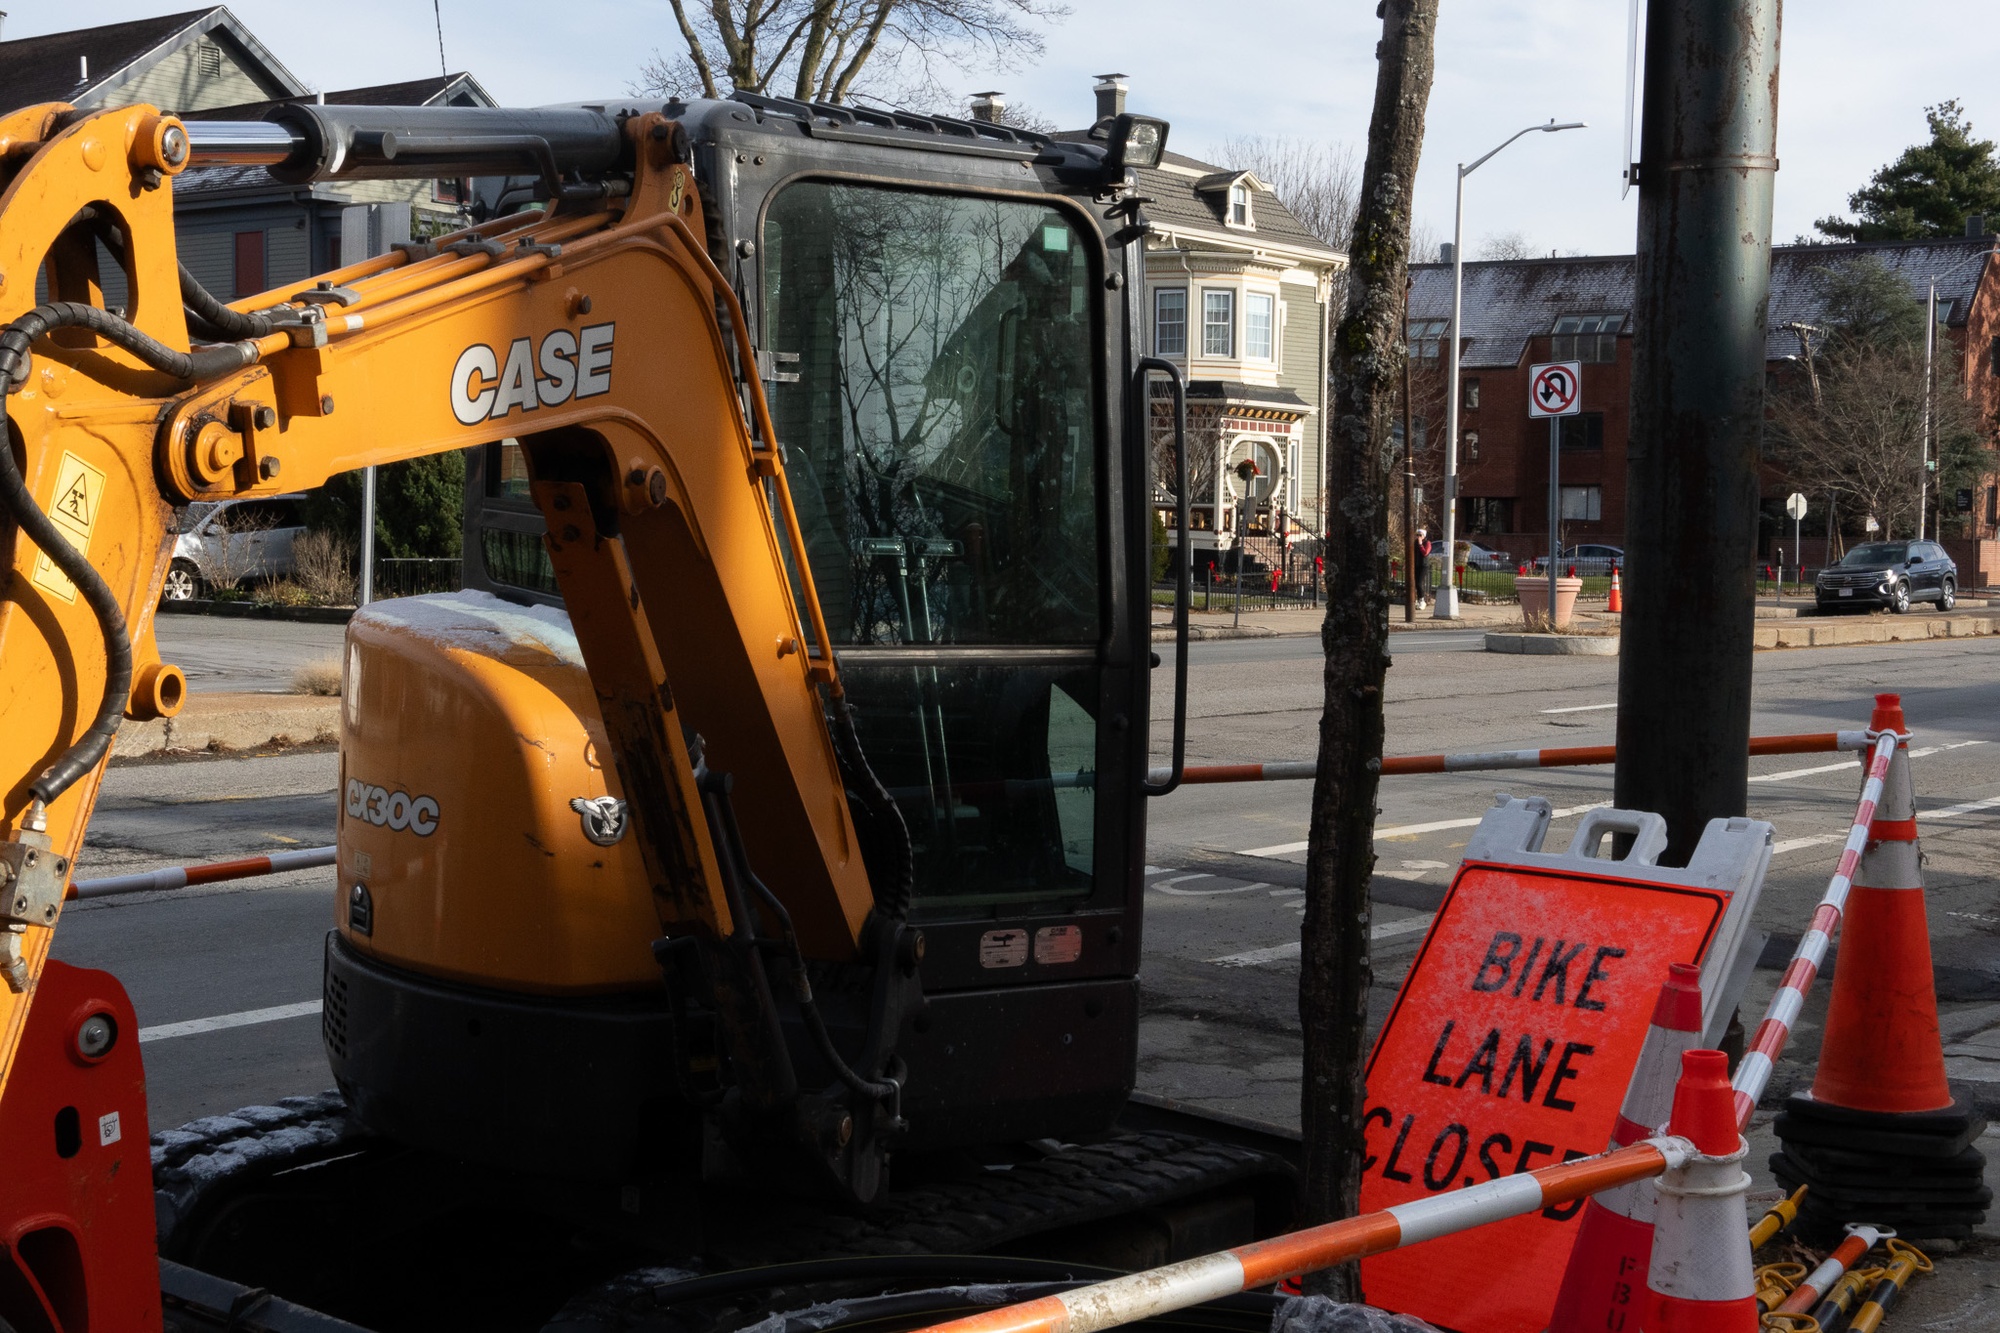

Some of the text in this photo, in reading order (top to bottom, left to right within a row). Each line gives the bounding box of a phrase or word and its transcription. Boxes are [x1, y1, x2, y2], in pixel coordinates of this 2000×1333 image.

[449, 321, 615, 426] CASE
[346, 778, 441, 837] CX30C
[1473, 932, 1626, 1011] BIKE
[1423, 1020, 1594, 1111] LANE
